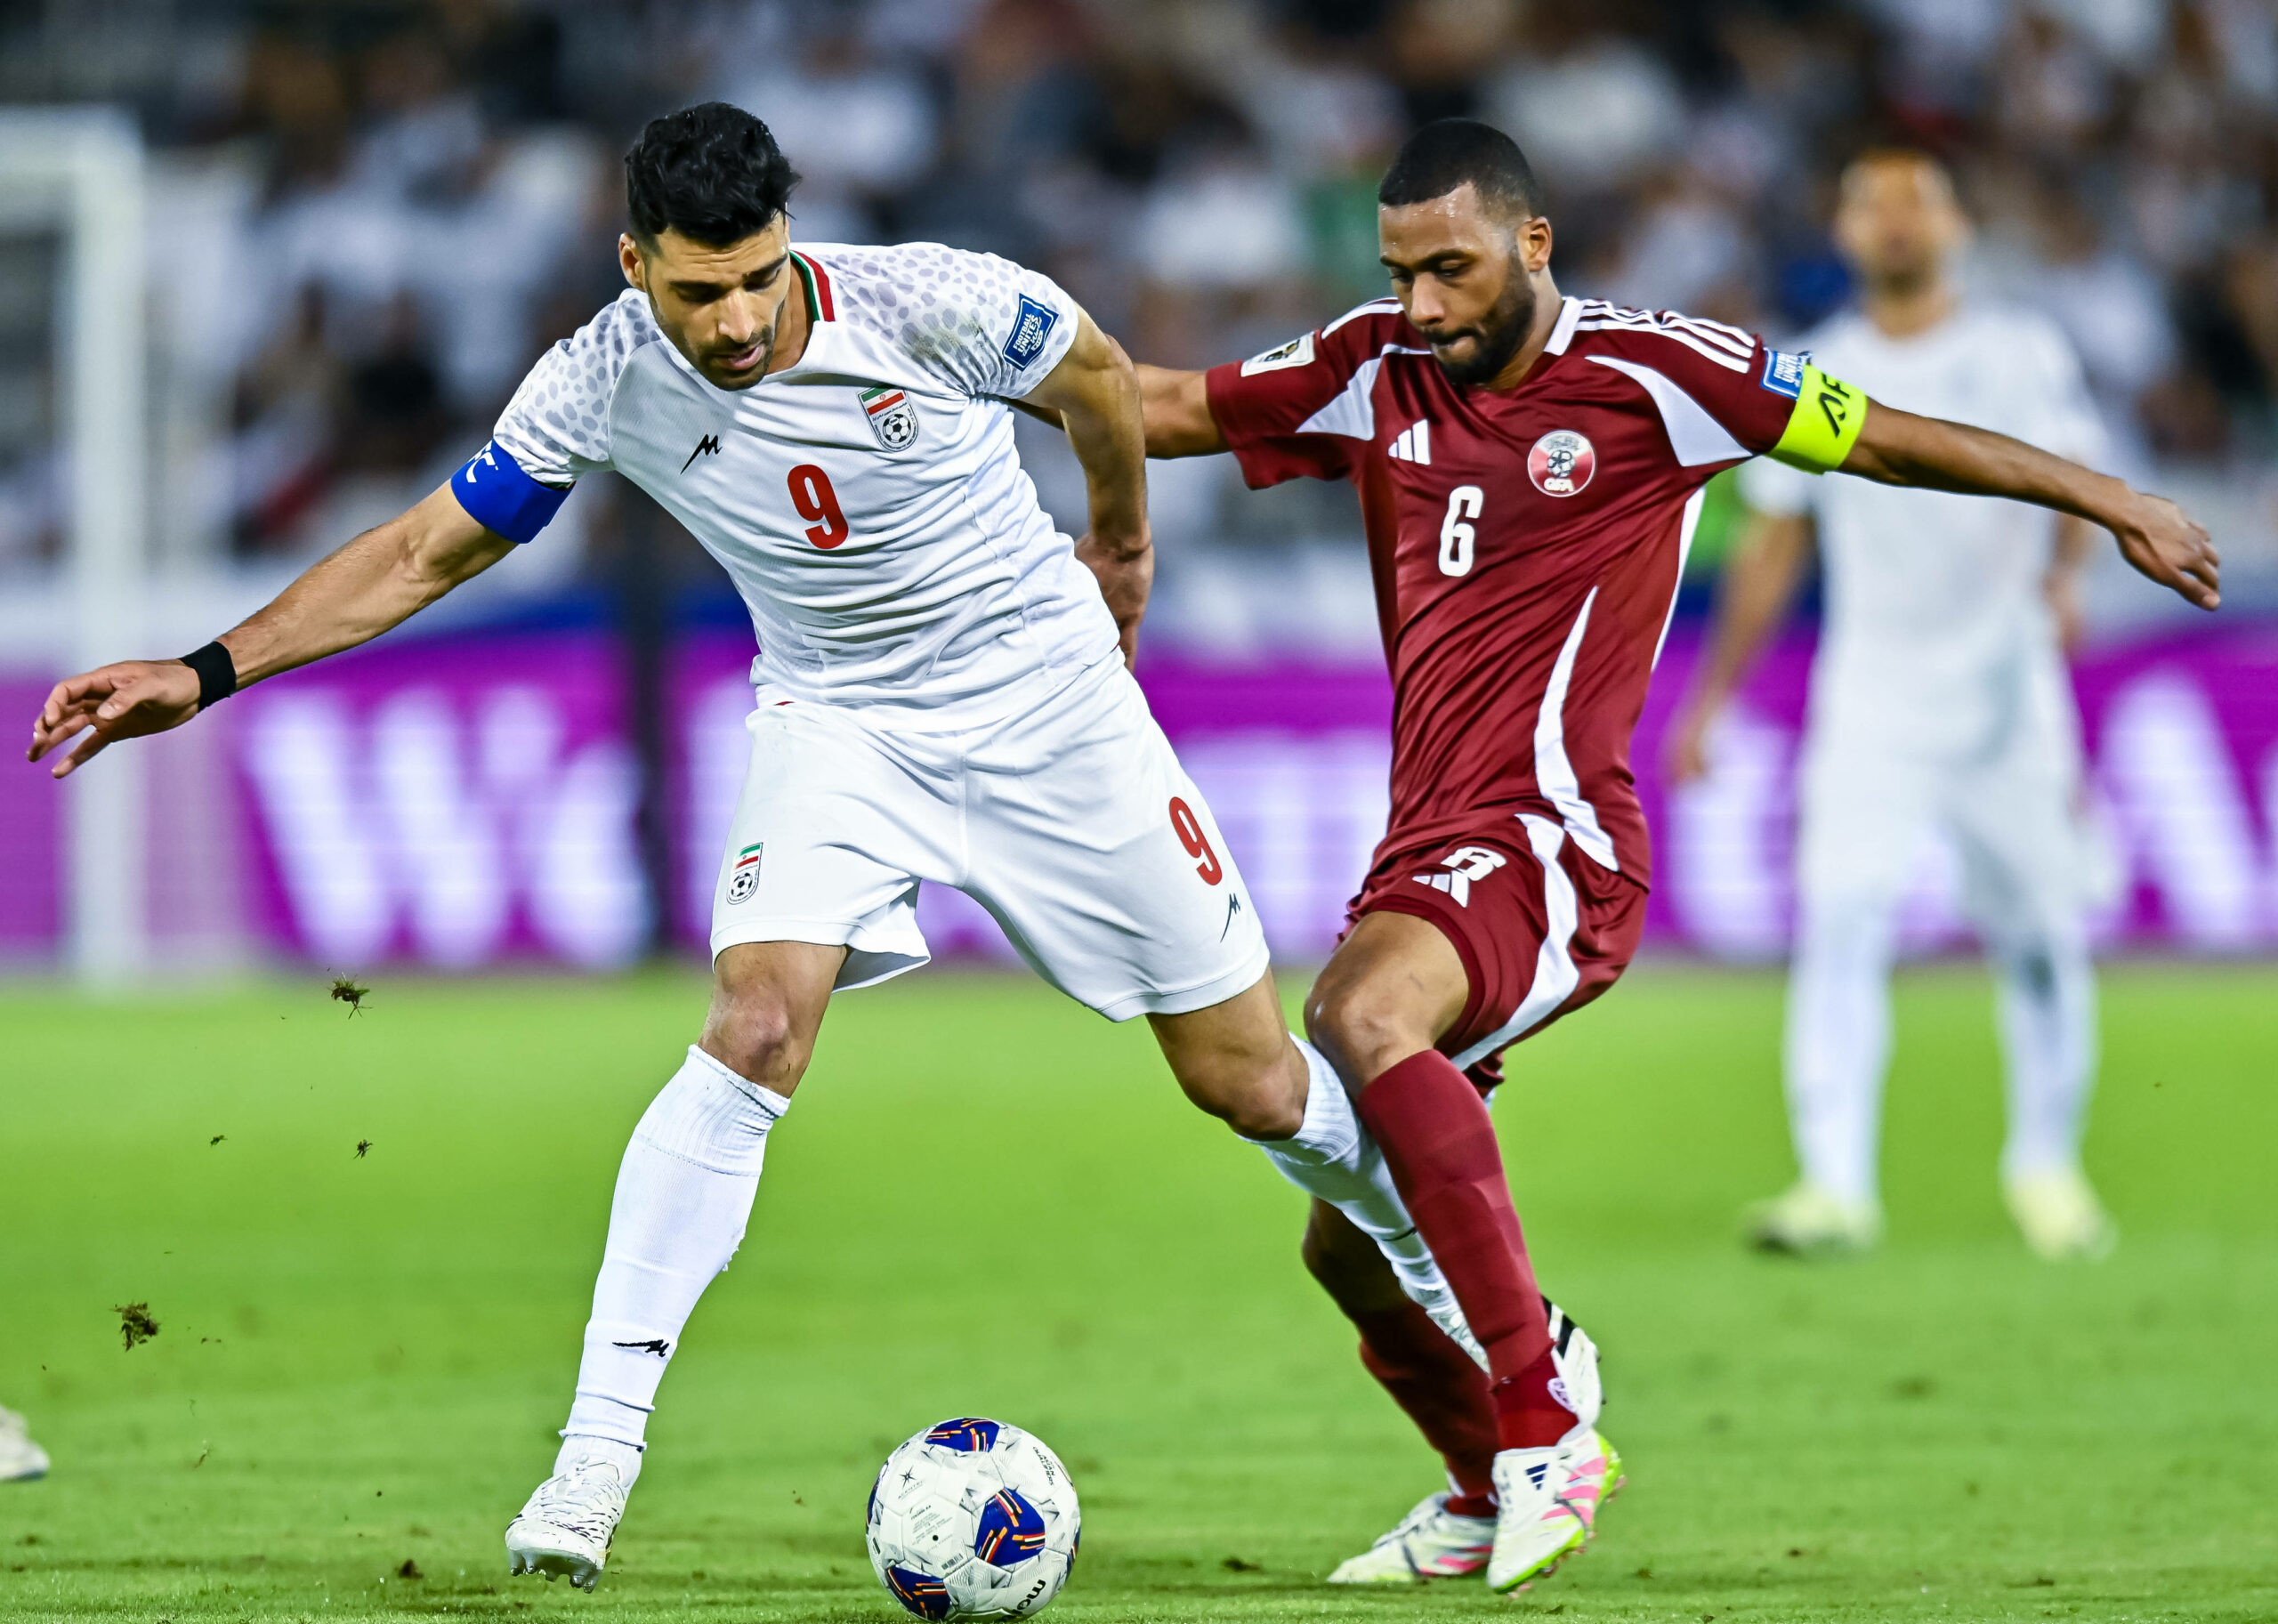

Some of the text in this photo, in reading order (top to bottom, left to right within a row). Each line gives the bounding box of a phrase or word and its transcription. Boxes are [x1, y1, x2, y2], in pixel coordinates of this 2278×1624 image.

[1013, 313, 1032, 349] FOOTBALL
[1018, 315, 1039, 353] UNITES
[1818, 372, 1851, 439] AF
[787, 464, 850, 550] 9
[1438, 484, 1484, 578] 6
[1168, 796, 1223, 886] 9
[1032, 1446, 1054, 1486] QUALIFIERS
[1040, 1454, 1056, 1476] ASIAN
